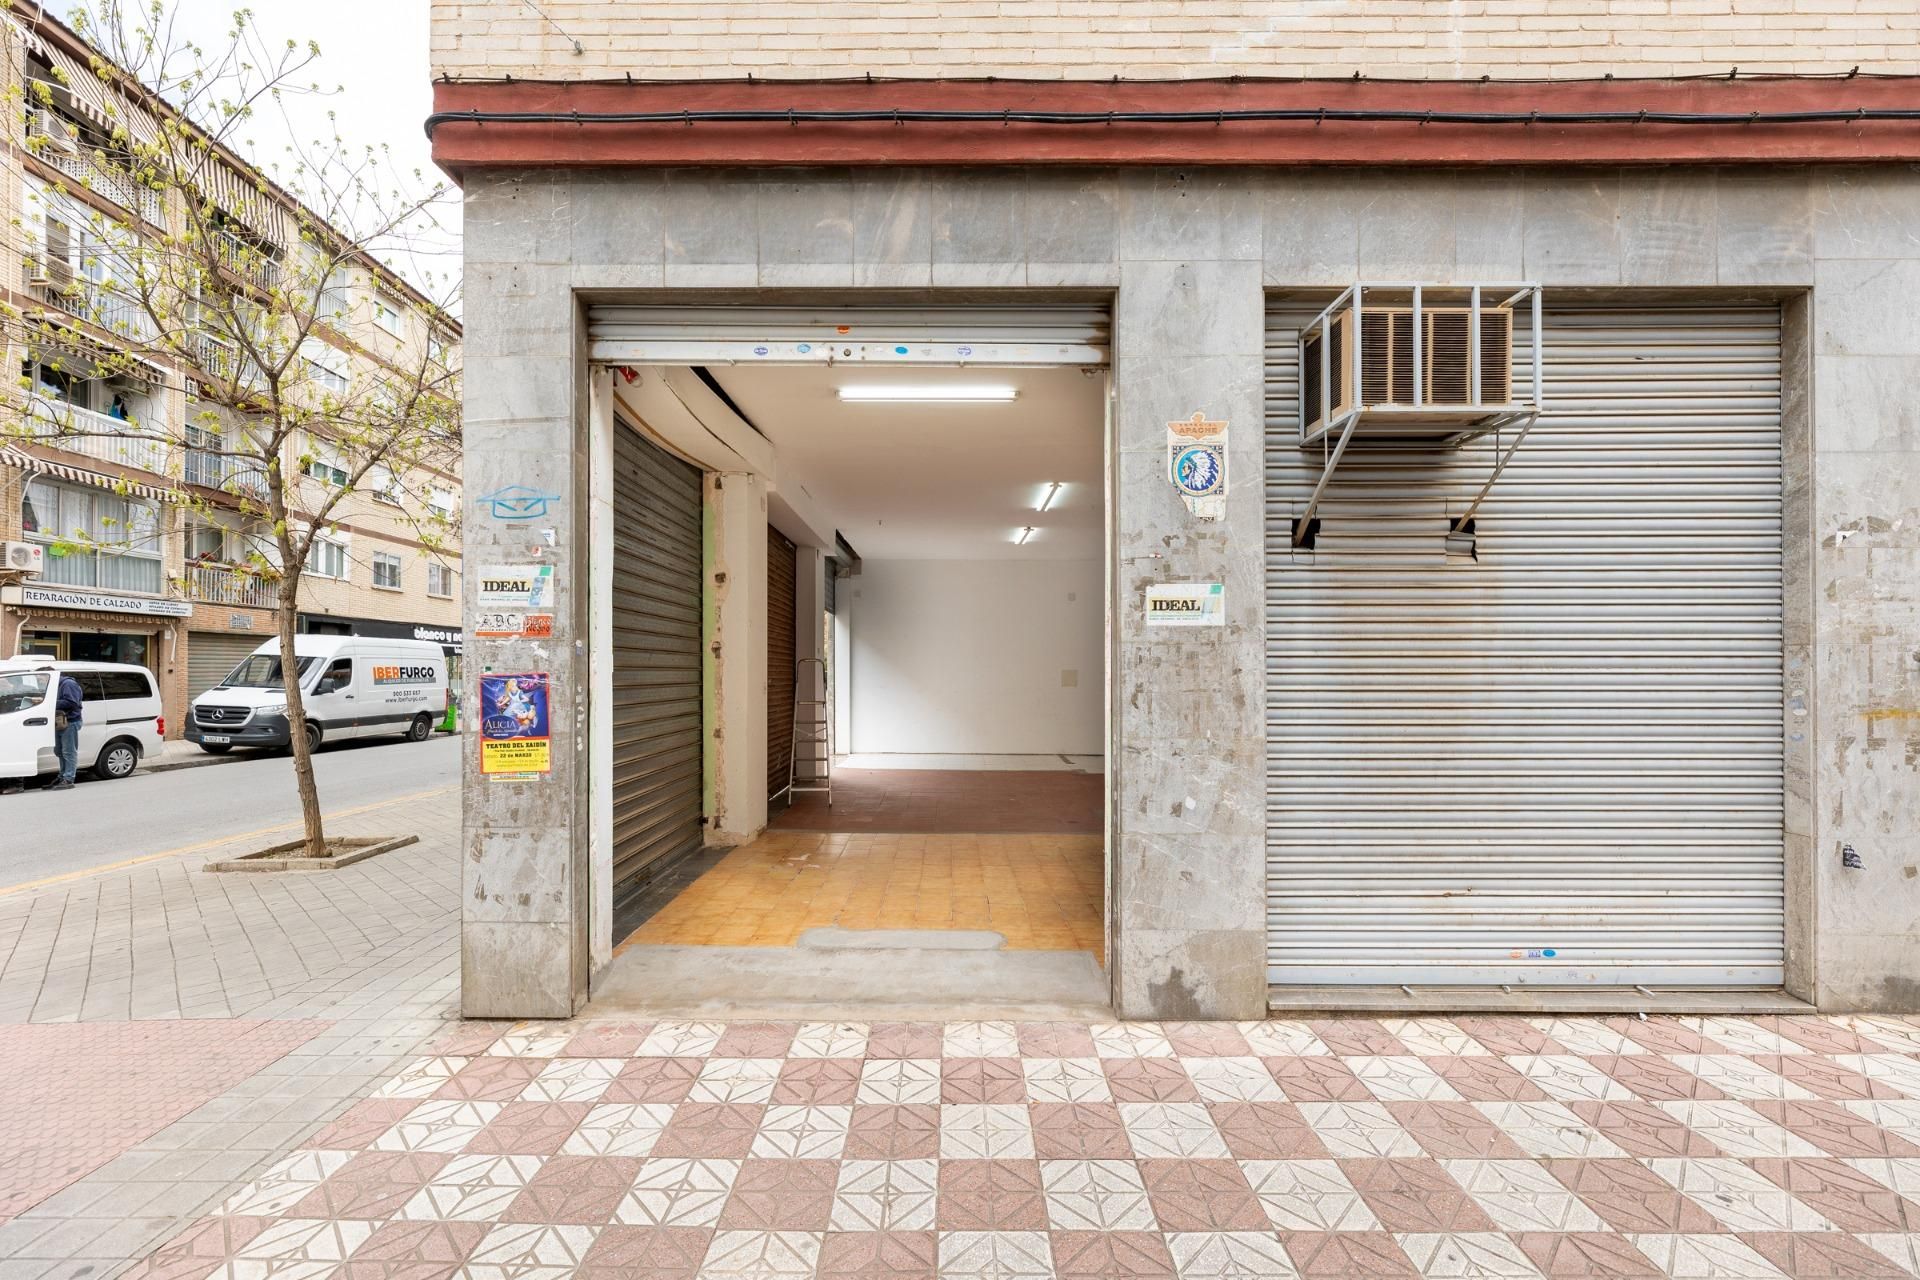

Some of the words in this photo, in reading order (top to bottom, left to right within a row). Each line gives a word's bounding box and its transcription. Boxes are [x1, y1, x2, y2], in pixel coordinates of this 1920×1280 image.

[482, 580, 530, 592] IDEAL
[25, 591, 87, 605] REPARACIÓN
[89, 597, 101, 606] DE
[103, 598, 142, 609] CALZADO
[1151, 600, 1200, 611] IDEAL
[414, 627, 445, 640] blanco
[373, 666, 435, 680] IBERFURGO
